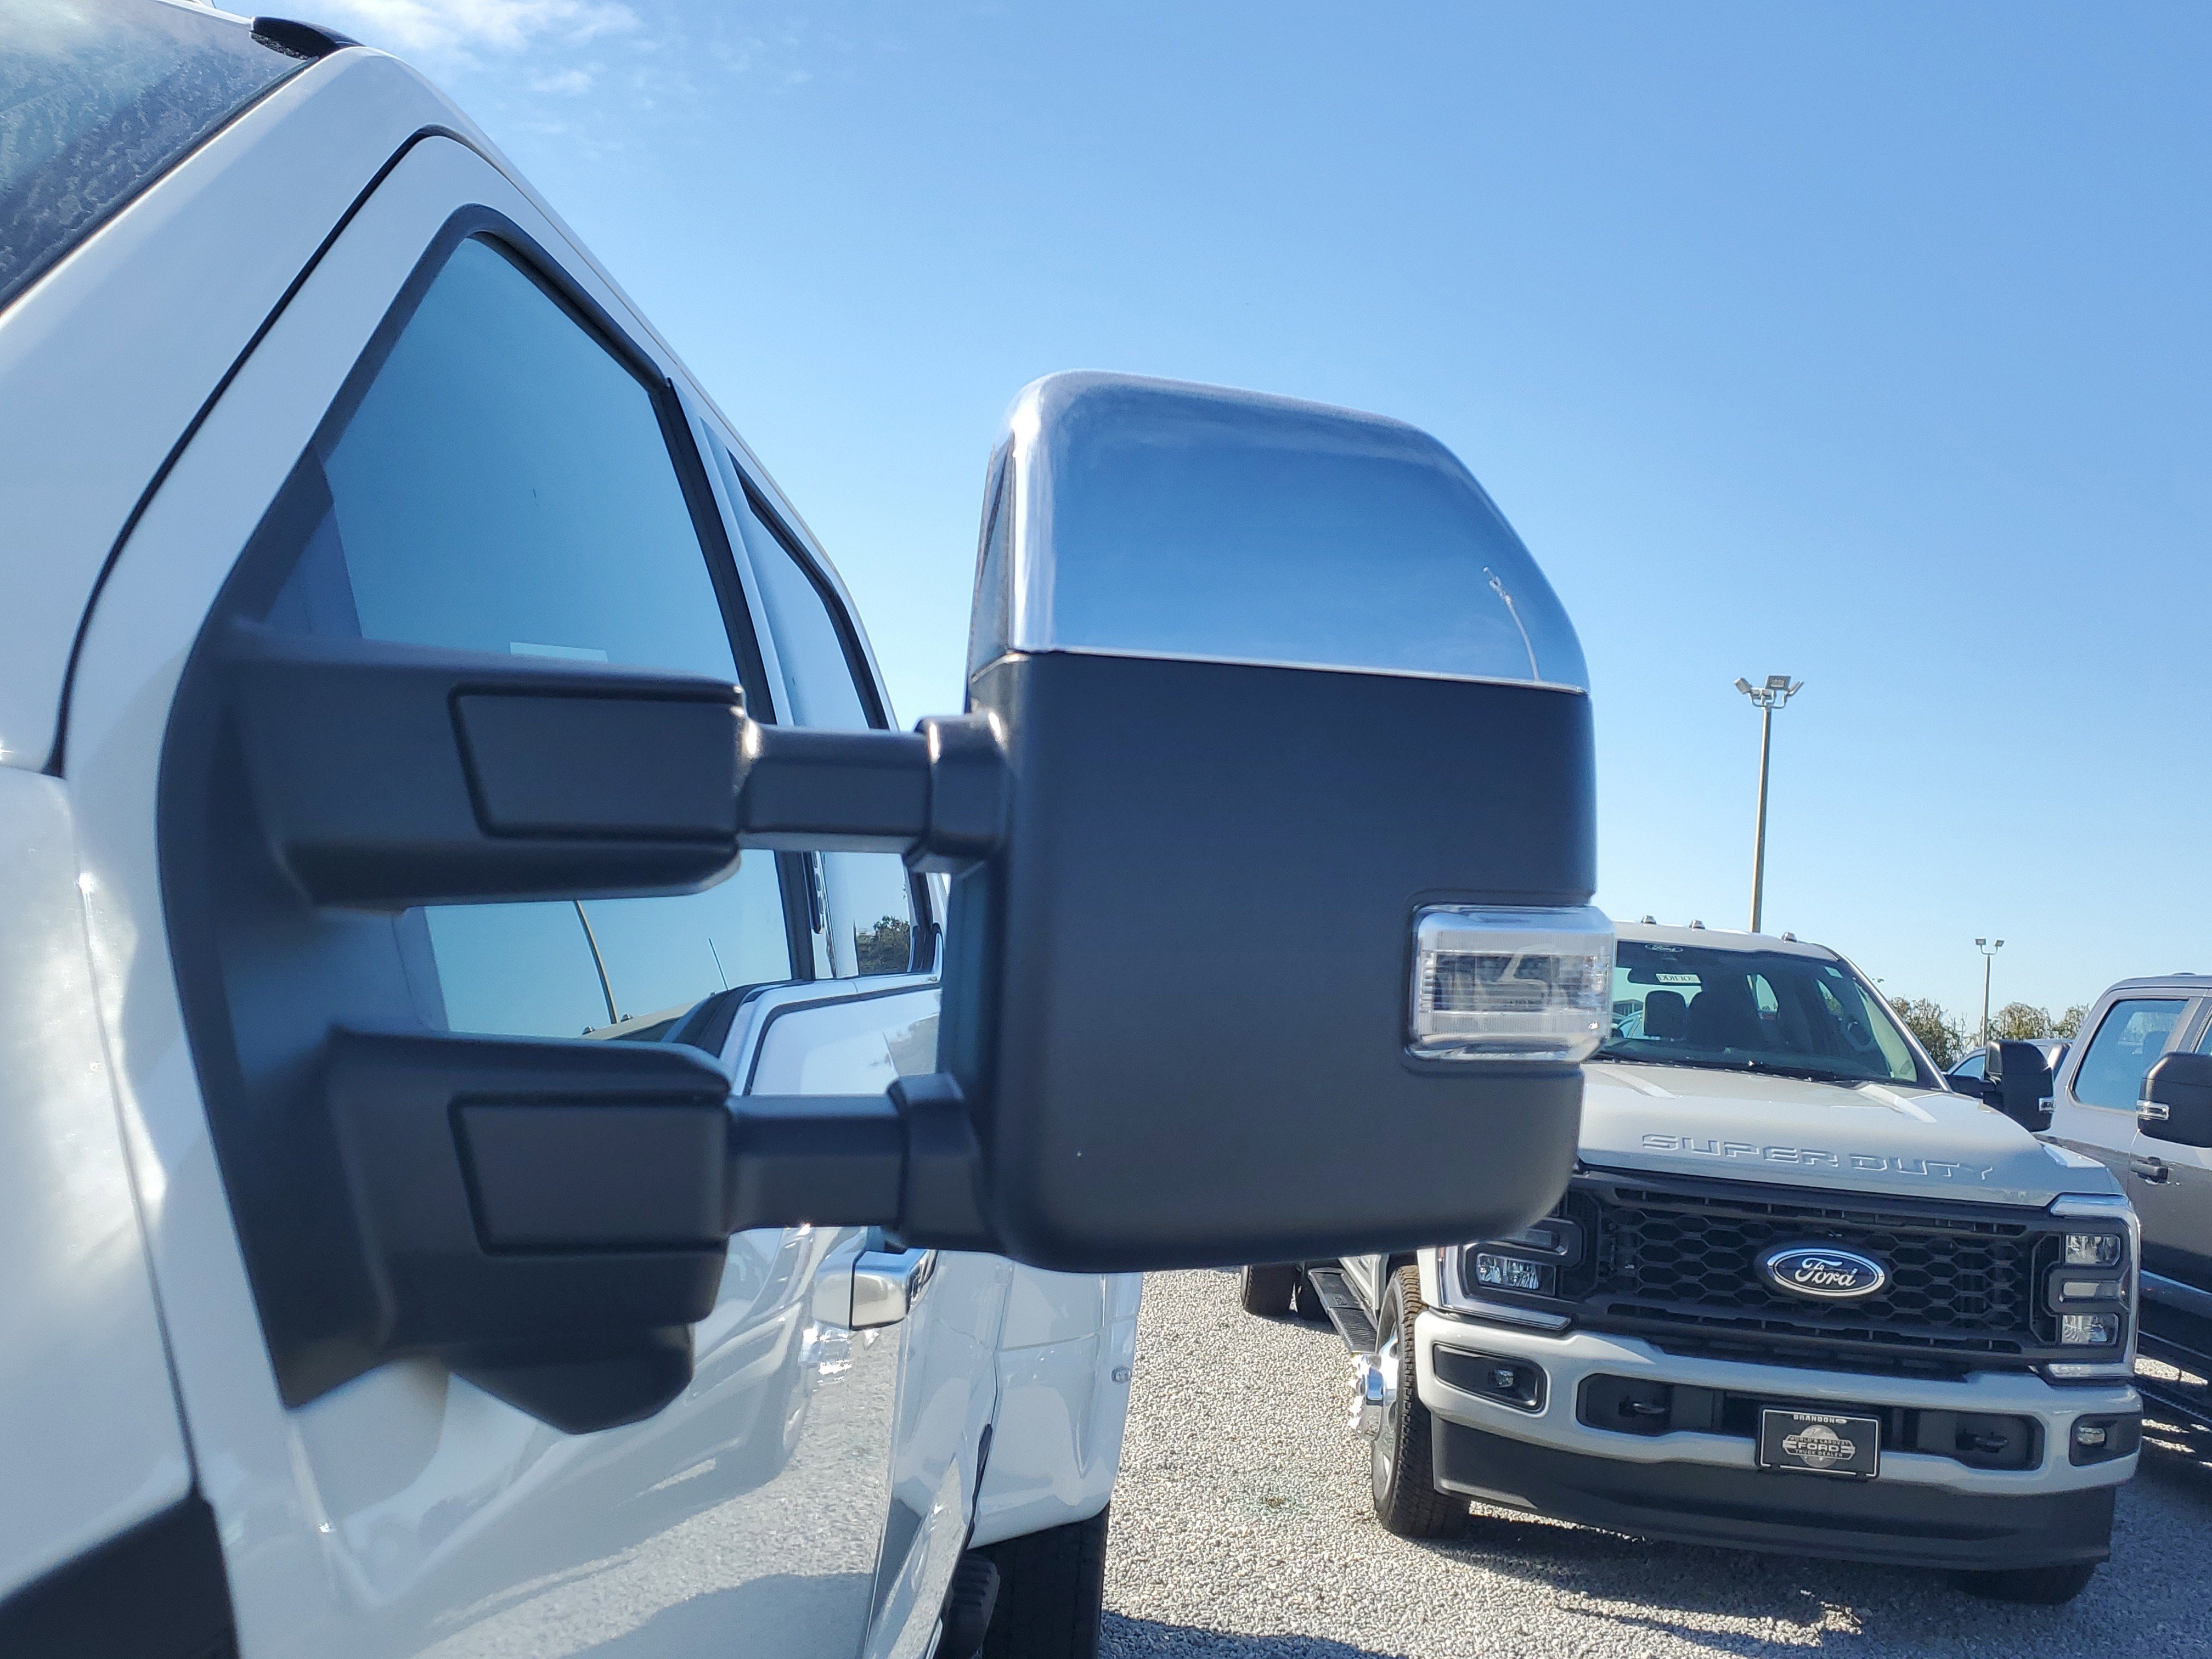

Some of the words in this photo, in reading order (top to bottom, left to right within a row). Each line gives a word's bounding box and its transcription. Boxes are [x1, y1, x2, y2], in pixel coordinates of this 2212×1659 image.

[1643, 1133, 1838, 1167] SUPER
[1849, 1153, 1993, 1180] DUTY
[1795, 1257, 1859, 1286] Ford
[1793, 1414, 1835, 1424] BRANDON
[1798, 1442, 1839, 1452] FORD
[1819, 1438, 1850, 1447] LARGEST
